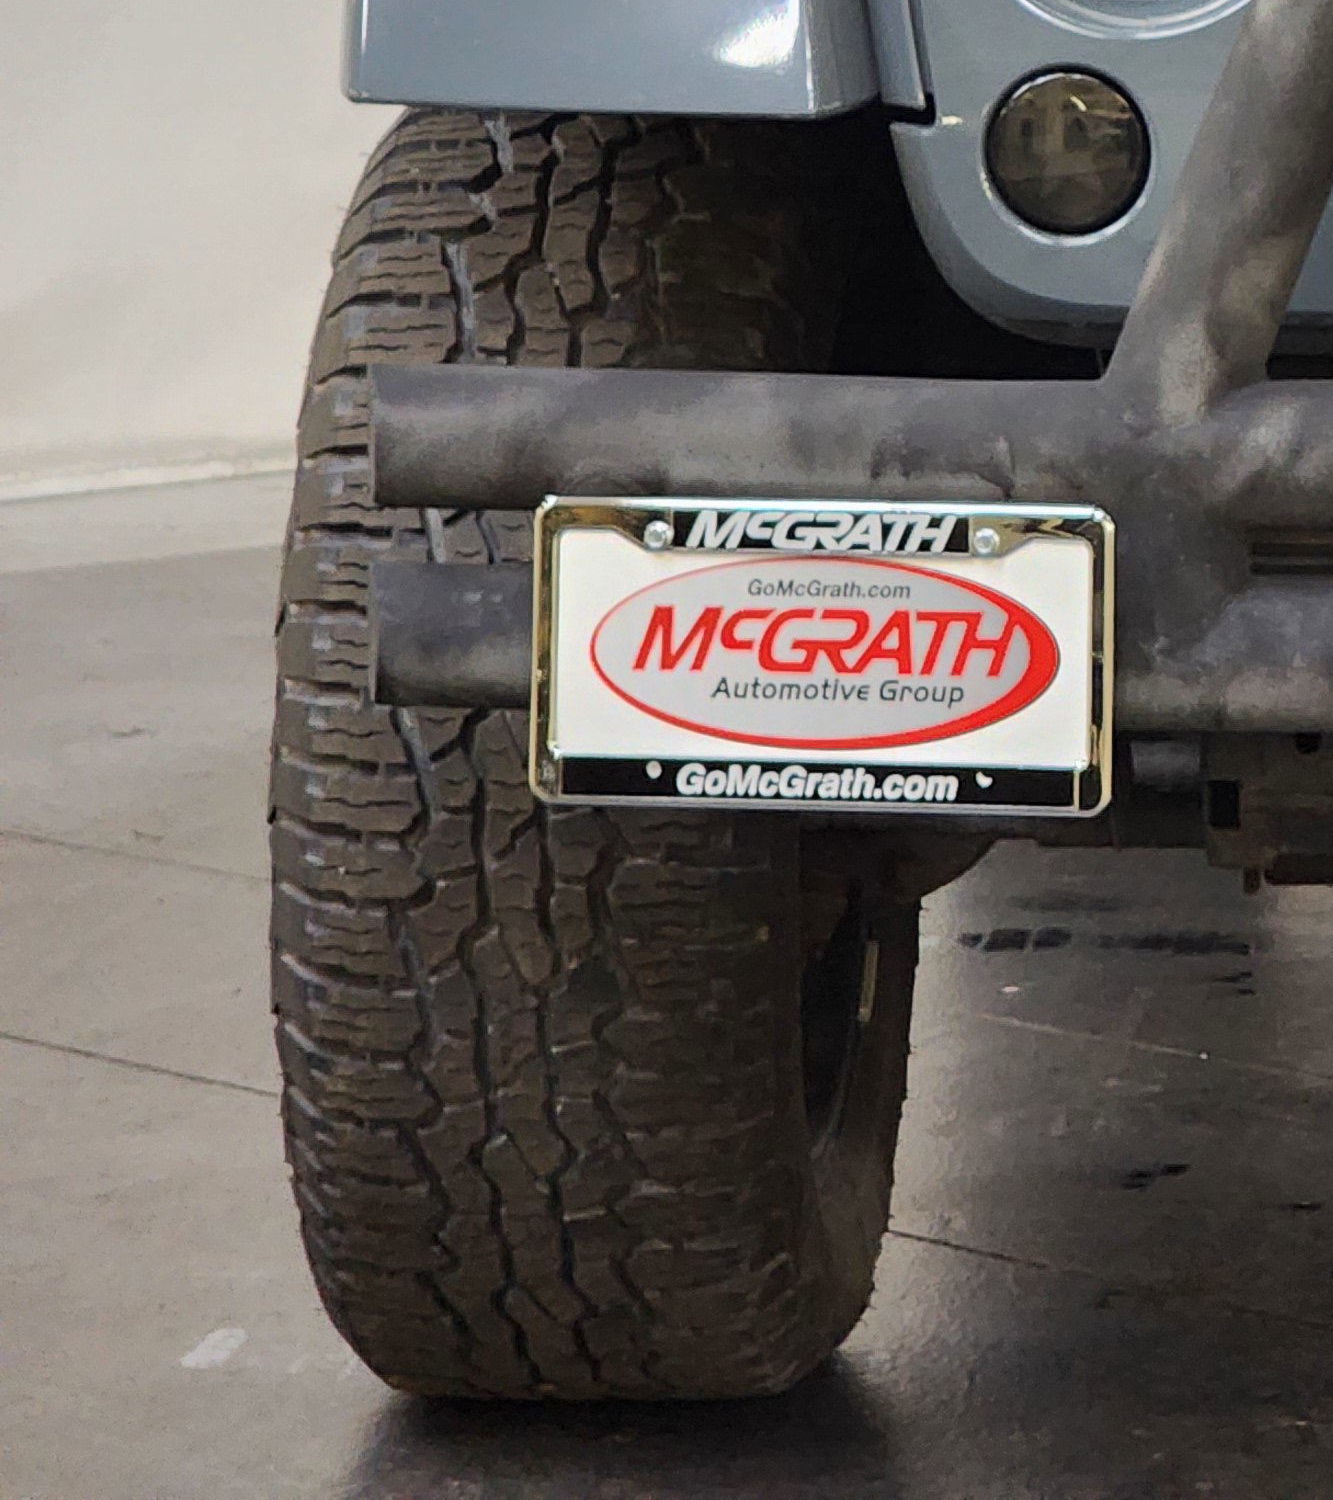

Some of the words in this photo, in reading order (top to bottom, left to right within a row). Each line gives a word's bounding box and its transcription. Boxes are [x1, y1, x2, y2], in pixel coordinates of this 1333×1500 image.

[747, 578, 911, 601] GoMcGrath.com
[711, 676, 870, 702] Automotive
[880, 679, 965, 708] Group
[676, 761, 959, 801] GoMcGrath.com
